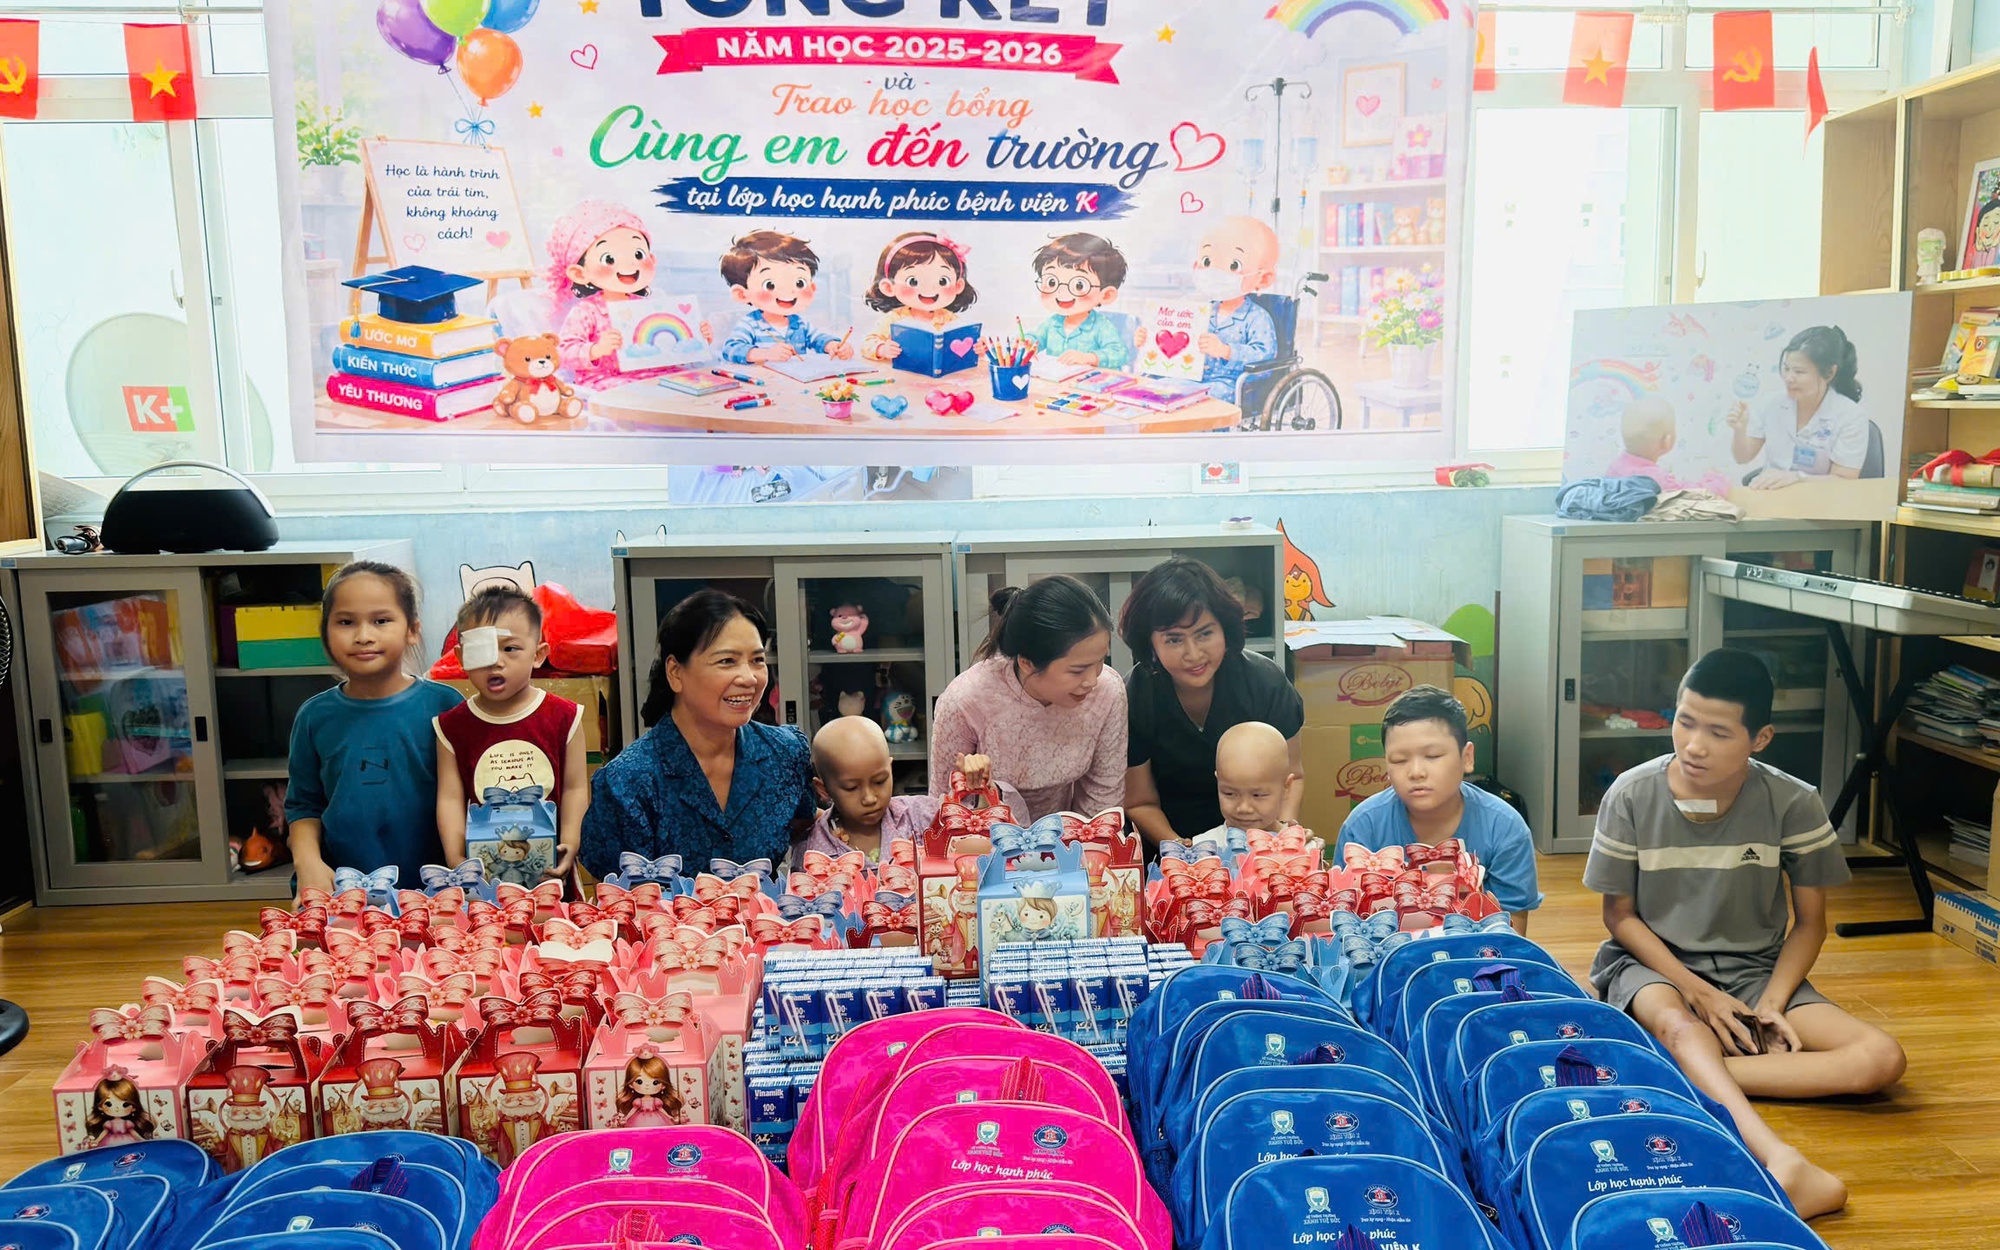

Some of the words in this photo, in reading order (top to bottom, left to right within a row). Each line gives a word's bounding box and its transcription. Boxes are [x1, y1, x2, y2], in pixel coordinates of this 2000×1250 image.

[716, 30, 793, 58] NĂM
[803, 35, 875, 63] HỌC
[885, 36, 1062, 65] 2025-2026
[885, 73, 916, 90] và
[771, 83, 857, 116] Trao
[868, 88, 932, 120] học
[945, 87, 1033, 129] bổng
[589, 104, 748, 183] Cùng
[763, 132, 848, 166] em
[866, 122, 969, 168] đến
[985, 127, 1168, 190] trường
[385, 164, 411, 178] Học
[415, 165, 429, 177] là
[433, 166, 466, 177] hành
[469, 168, 500, 179] trình
[407, 185, 431, 197] của
[436, 187, 460, 197] trái
[464, 187, 489, 199] tim,
[687, 187, 721, 208] tại
[728, 184, 767, 215] lớp
[771, 184, 815, 212] học
[820, 186, 885, 214] hạnh
[887, 188, 950, 218] phúc
[956, 188, 1013, 222] bệnh
[1020, 191, 1069, 217] viện
[1075, 190, 1098, 213] K
[406, 206, 446, 221] không
[437, 226, 473, 239] cách!
[396, 334, 417, 348] MƠ
[381, 361, 417, 378] THỨC
[338, 383, 362, 399] YÊU
[366, 389, 423, 411] THƯƠNG
[132, 394, 184, 424] K+
[754, 1088, 784, 1098] Vinamilk
[951, 1159, 972, 1172] Lớp
[973, 1161, 994, 1175] học
[995, 1164, 1024, 1178] hạnh
[1026, 1167, 1054, 1180] phúc
[1587, 1180, 1607, 1192] Lớp
[1609, 1179, 1629, 1190] học
[1629, 1176, 1657, 1188] hạnh
[1658, 1174, 1684, 1187] phúc
[1292, 1232, 1313, 1244] Lớp
[1316, 1231, 1336, 1243] học
[1369, 1228, 1397, 1240] phúc
